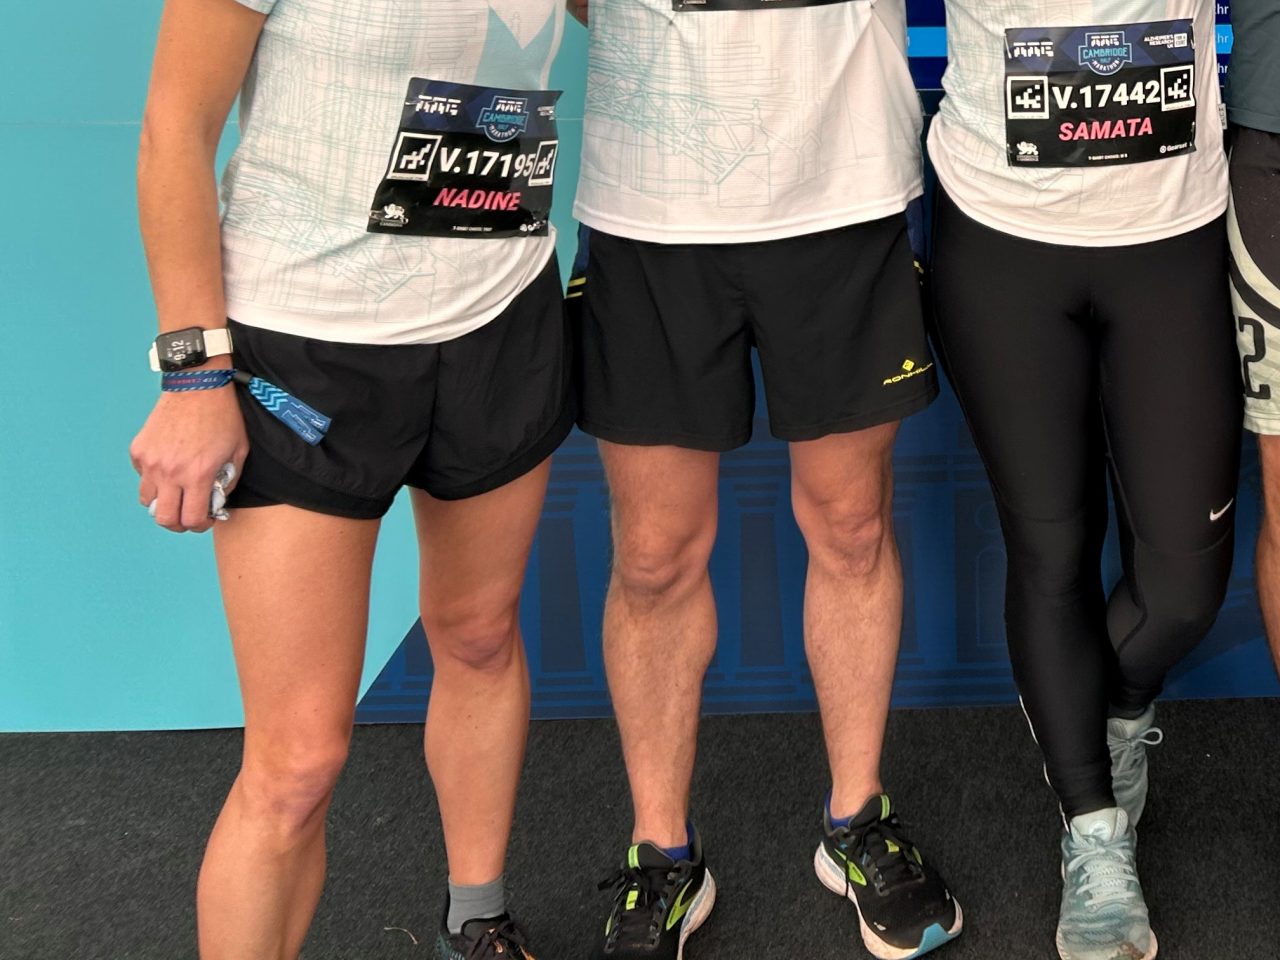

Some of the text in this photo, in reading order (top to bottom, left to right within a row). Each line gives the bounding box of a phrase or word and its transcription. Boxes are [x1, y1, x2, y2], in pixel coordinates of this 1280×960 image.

[1082, 46, 1128, 58] CAMBRIDGE
[1051, 80, 1161, 110] V.17442
[1058, 117, 1153, 141] SAMATA
[440, 147, 534, 179] V.17195
[433, 187, 521, 211] NADINE
[1238, 316, 1271, 400] 2
